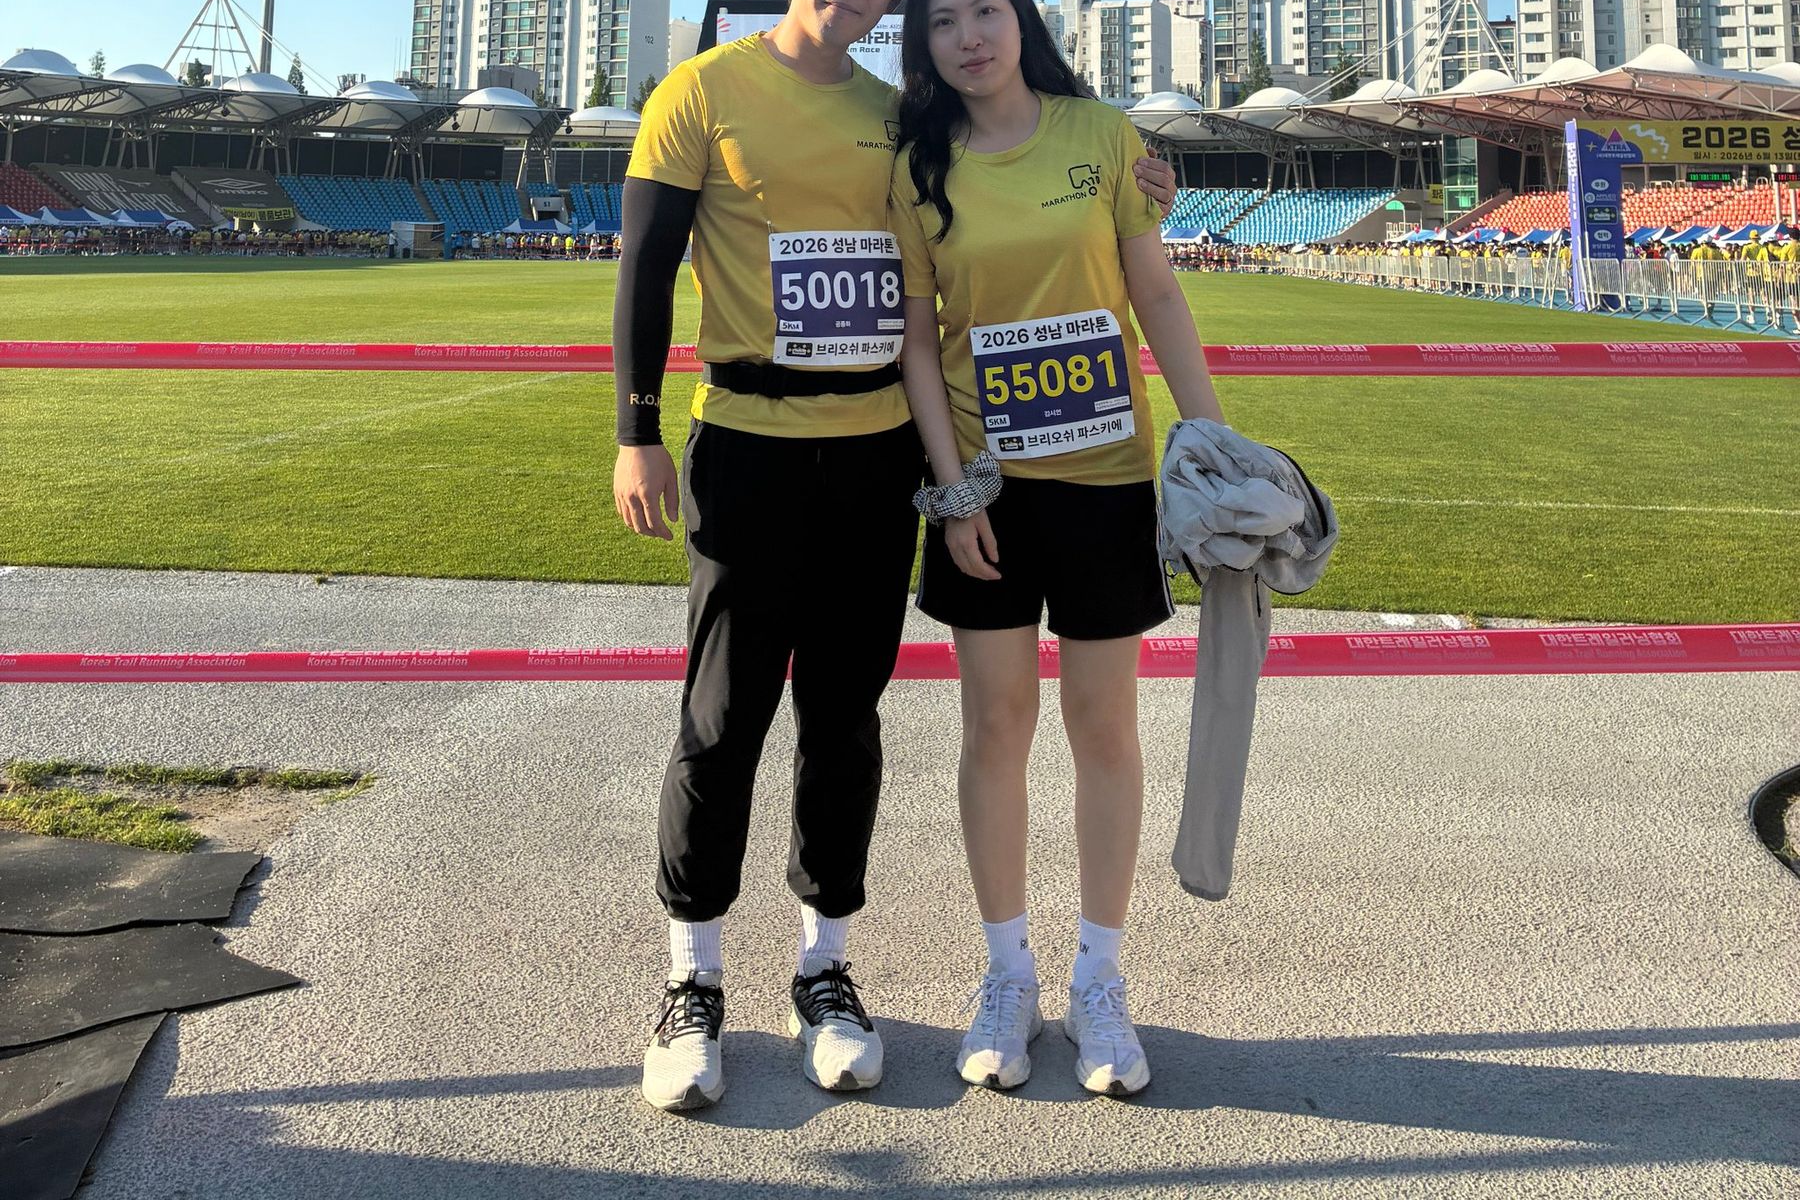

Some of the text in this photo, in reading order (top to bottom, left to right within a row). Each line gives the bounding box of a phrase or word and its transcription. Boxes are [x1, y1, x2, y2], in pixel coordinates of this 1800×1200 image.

[1682, 127, 1771, 148] 2026
[1720, 152, 1753, 160] 2026년
[1041, 192, 1087, 208] MARATHON
[780, 237, 894, 254] 2026 성남 마라톤
[781, 271, 900, 311] 50018
[782, 322, 800, 330] 5KM
[981, 316, 1110, 348] 2026 성남 마라톤
[414, 347, 569, 359] Korea Trail Running Association
[816, 341, 895, 356] 브리오쉬 파스키에
[1230, 352, 1371, 364] Korea Trail Running Association
[984, 350, 1117, 405] 55081
[988, 418, 1008, 427] 5KM
[1027, 418, 1123, 448] 브리오쉬 파스키에
[80, 657, 246, 668] Korea Trail Running Association
[307, 657, 468, 668] Korea Trail Running Association
[527, 656, 683, 667] Korea Trail Running Association
